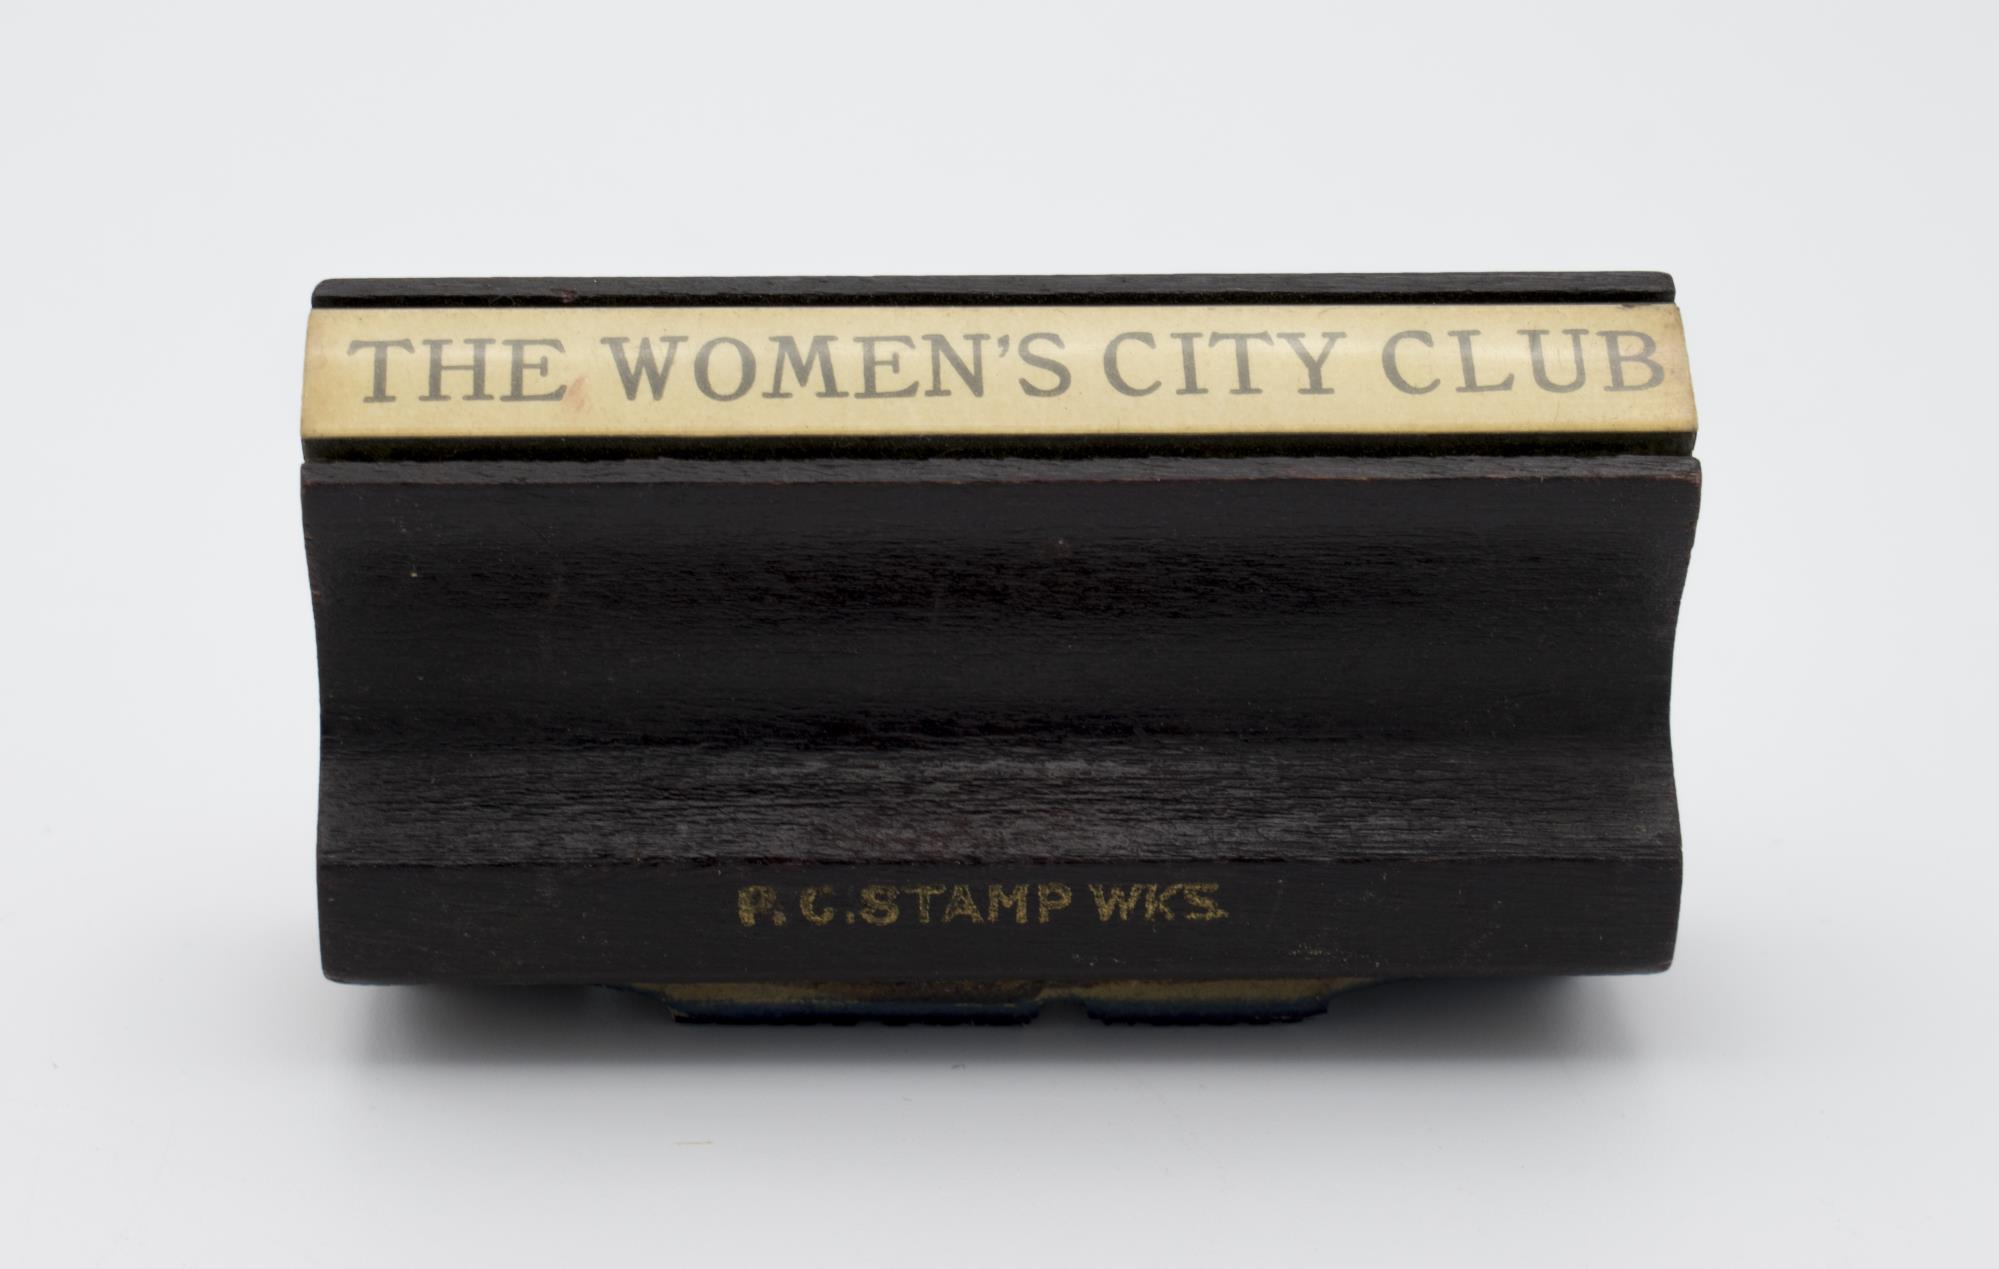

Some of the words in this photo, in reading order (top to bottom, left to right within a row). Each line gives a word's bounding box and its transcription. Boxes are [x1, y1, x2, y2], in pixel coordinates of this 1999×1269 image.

[346, 336, 569, 403] THE
[600, 329, 1073, 402] WOMEN'S
[1102, 328, 1347, 396] CITY
[1380, 326, 1667, 395] CLUB
